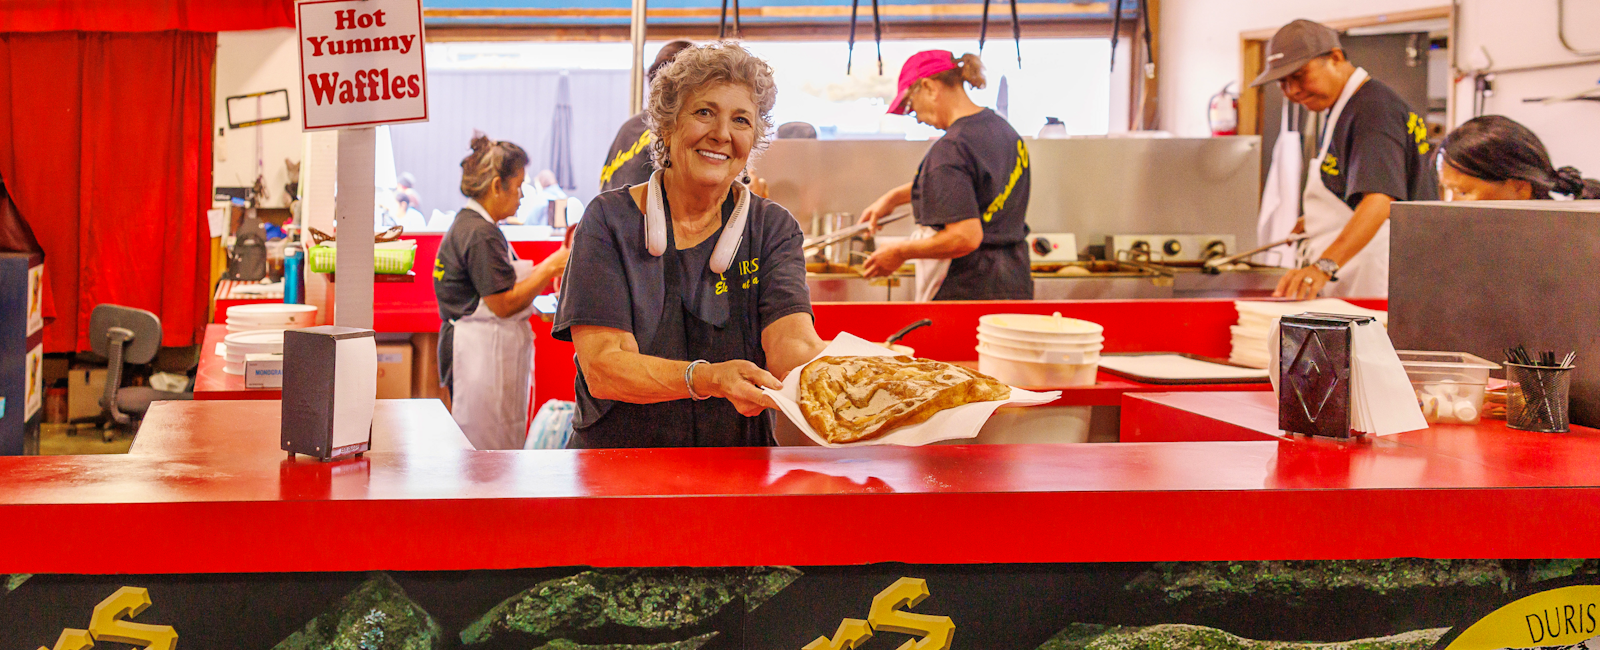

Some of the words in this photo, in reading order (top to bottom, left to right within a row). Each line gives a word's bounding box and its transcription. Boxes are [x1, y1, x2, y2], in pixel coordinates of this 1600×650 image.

[334, 9, 386, 30] Hot
[306, 34, 416, 57] Yummy
[307, 67, 420, 106] Waffles
[1525, 603, 1596, 643] DURIS
